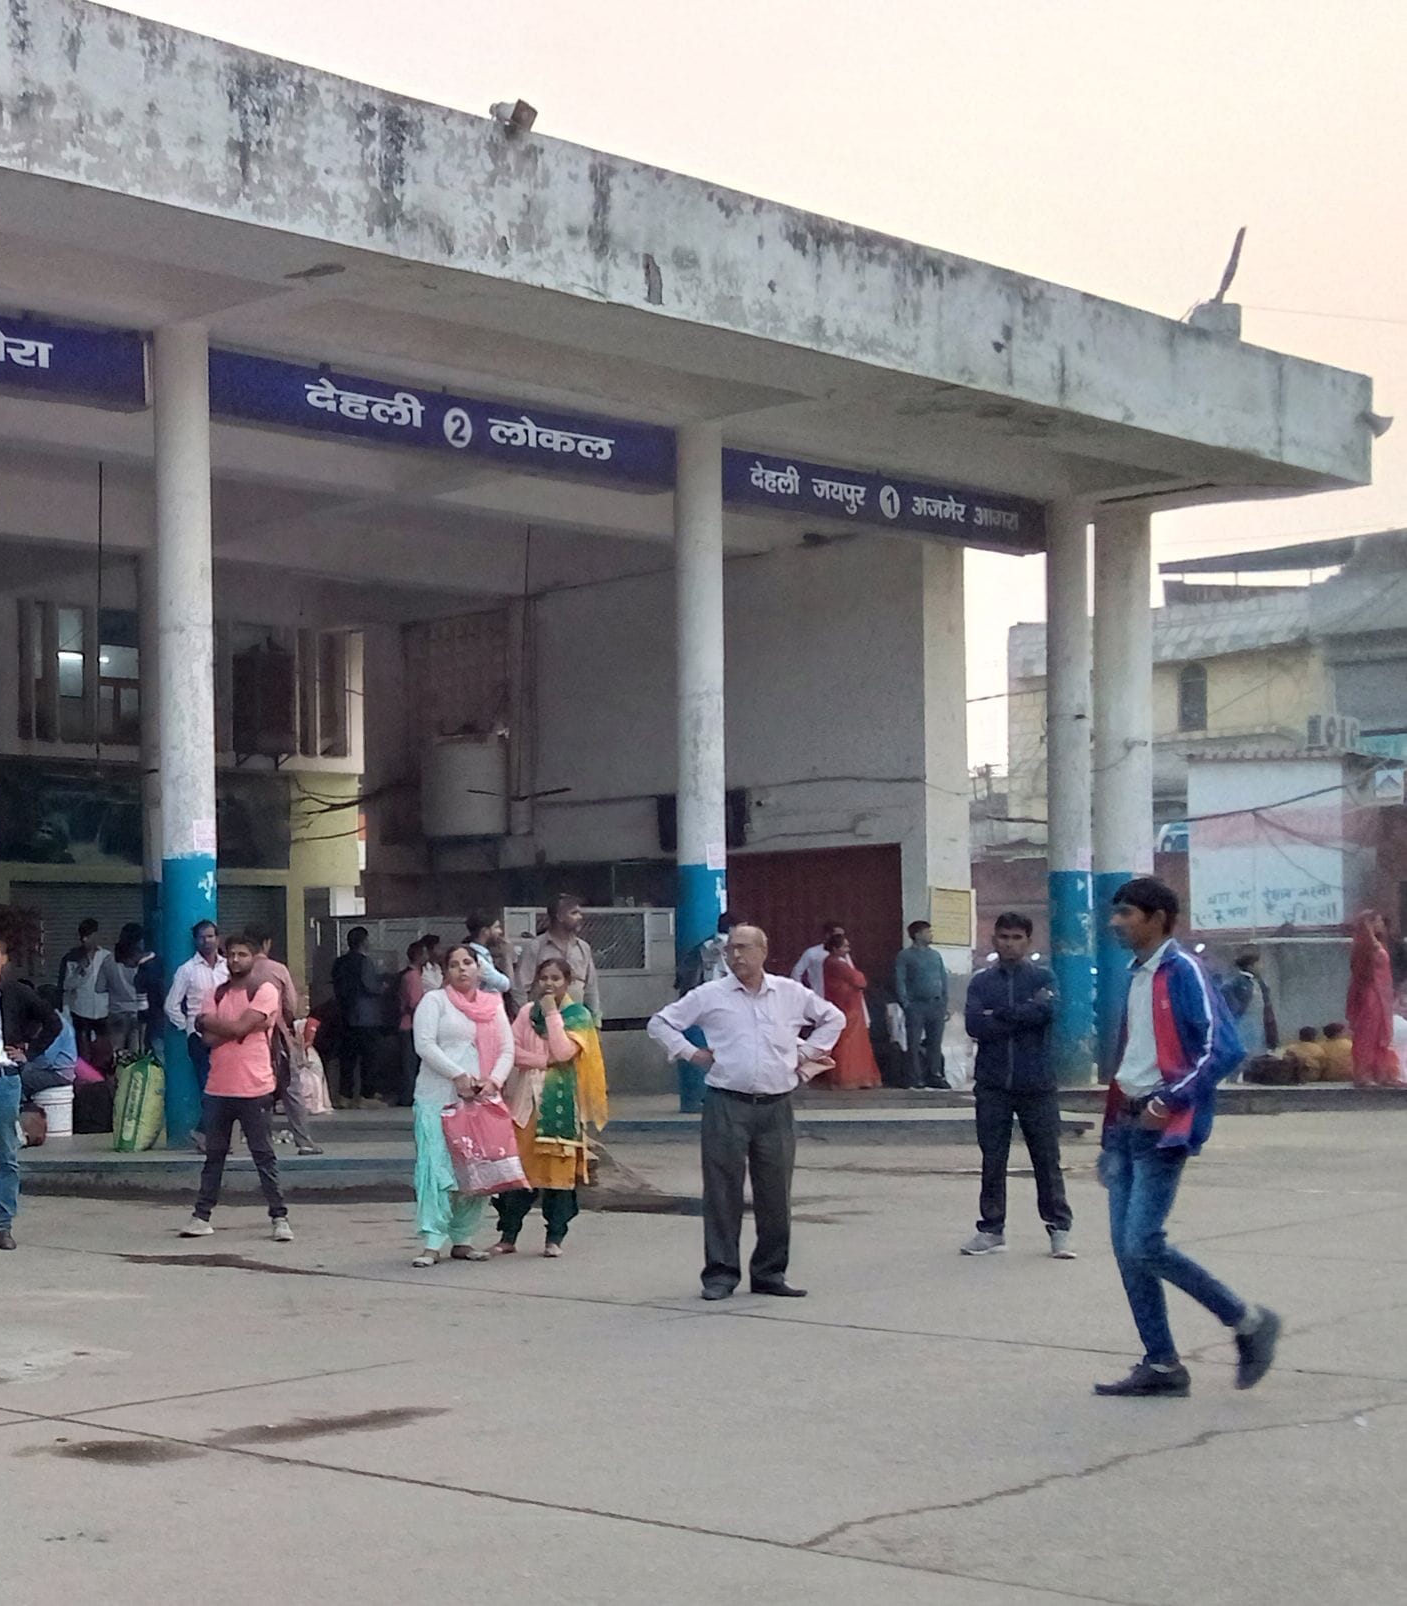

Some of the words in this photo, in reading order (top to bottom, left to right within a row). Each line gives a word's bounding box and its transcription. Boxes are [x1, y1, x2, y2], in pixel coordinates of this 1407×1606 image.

[305, 380, 425, 428] देहली
[451, 415, 465, 441] 2
[488, 416, 615, 461] लोकल
[749, 460, 801, 495] देहली
[811, 478, 867, 515] जयपुर
[912, 494, 967, 523] अजमेर
[973, 506, 1019, 531] आगरा
